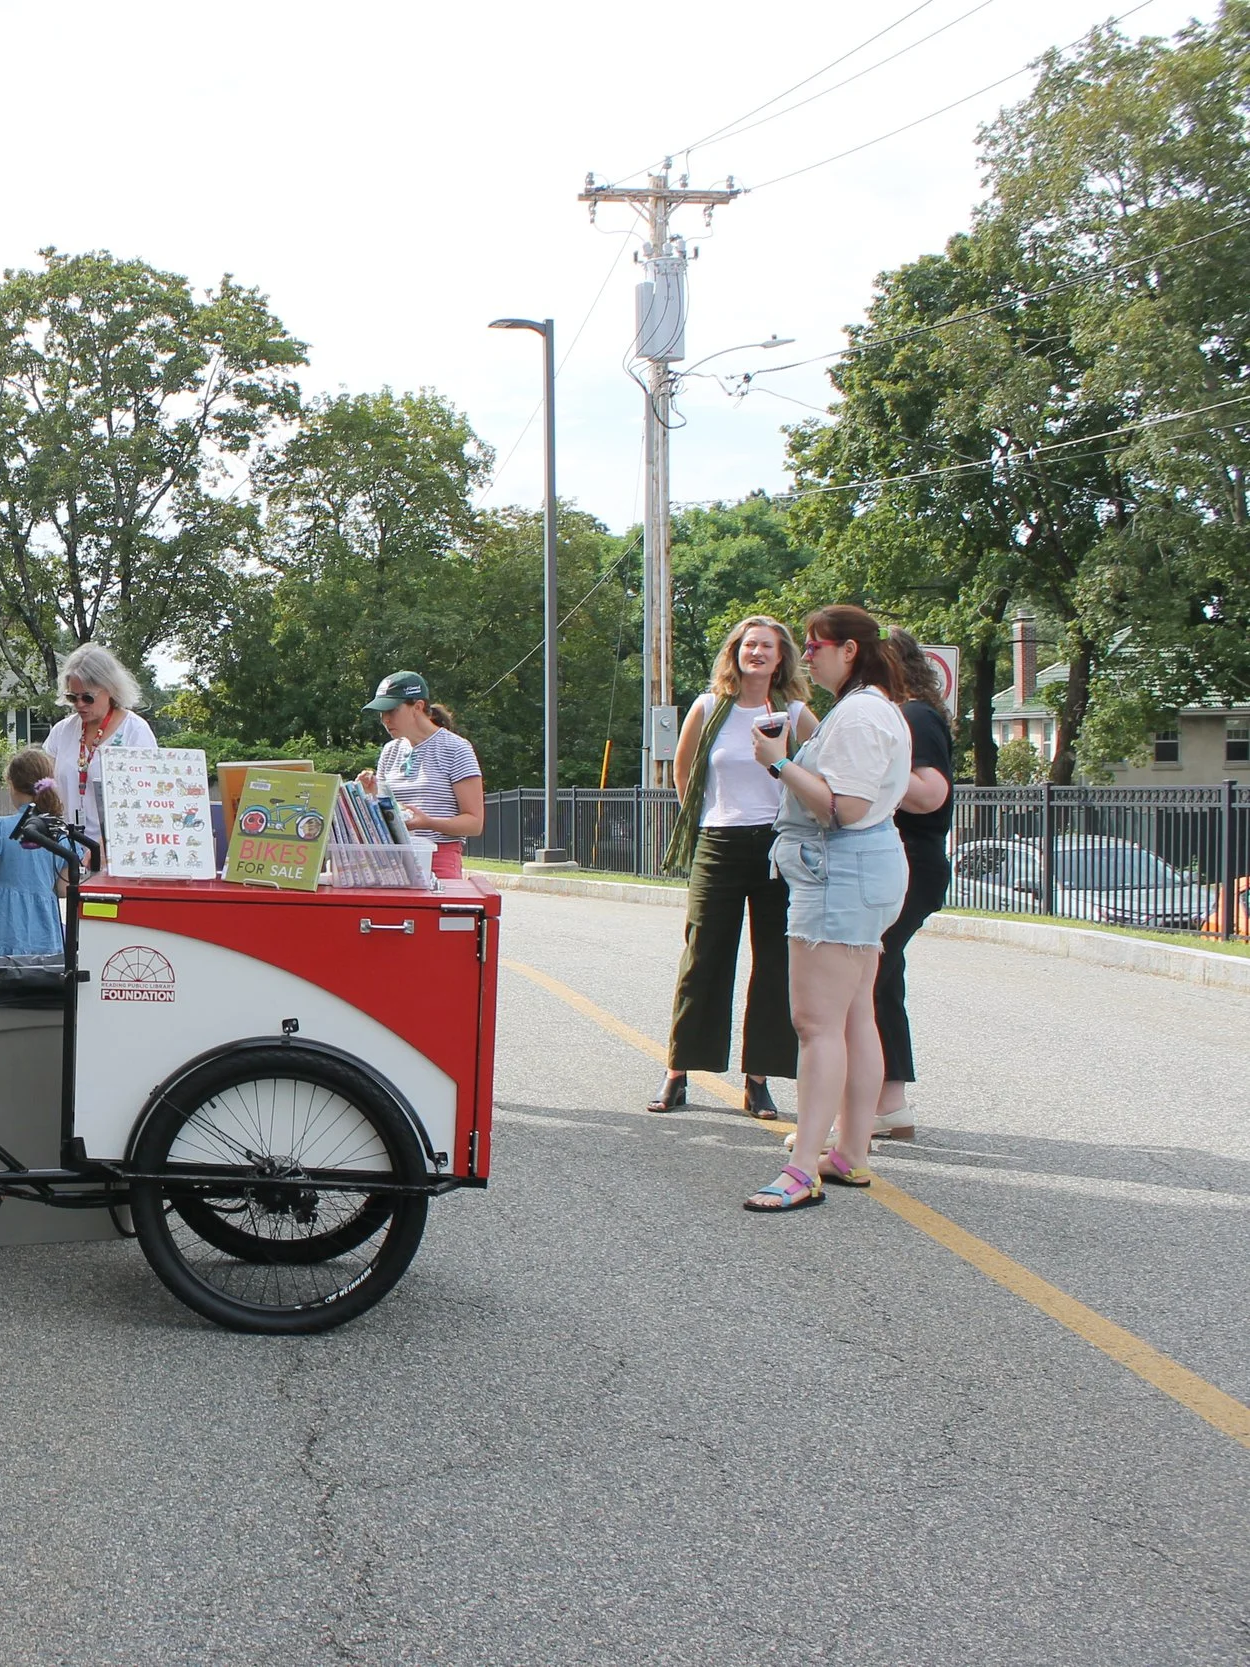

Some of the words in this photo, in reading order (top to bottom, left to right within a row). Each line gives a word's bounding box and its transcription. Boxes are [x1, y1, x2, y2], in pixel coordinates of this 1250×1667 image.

[137, 780, 152, 788] ON
[146, 800, 175, 809] YOUR
[145, 832, 181, 846] BIKE
[238, 838, 309, 866] BIKES
[236, 860, 265, 875] FOR
[269, 864, 304, 880] SALE
[102, 990, 175, 1001] FOUNDATION
